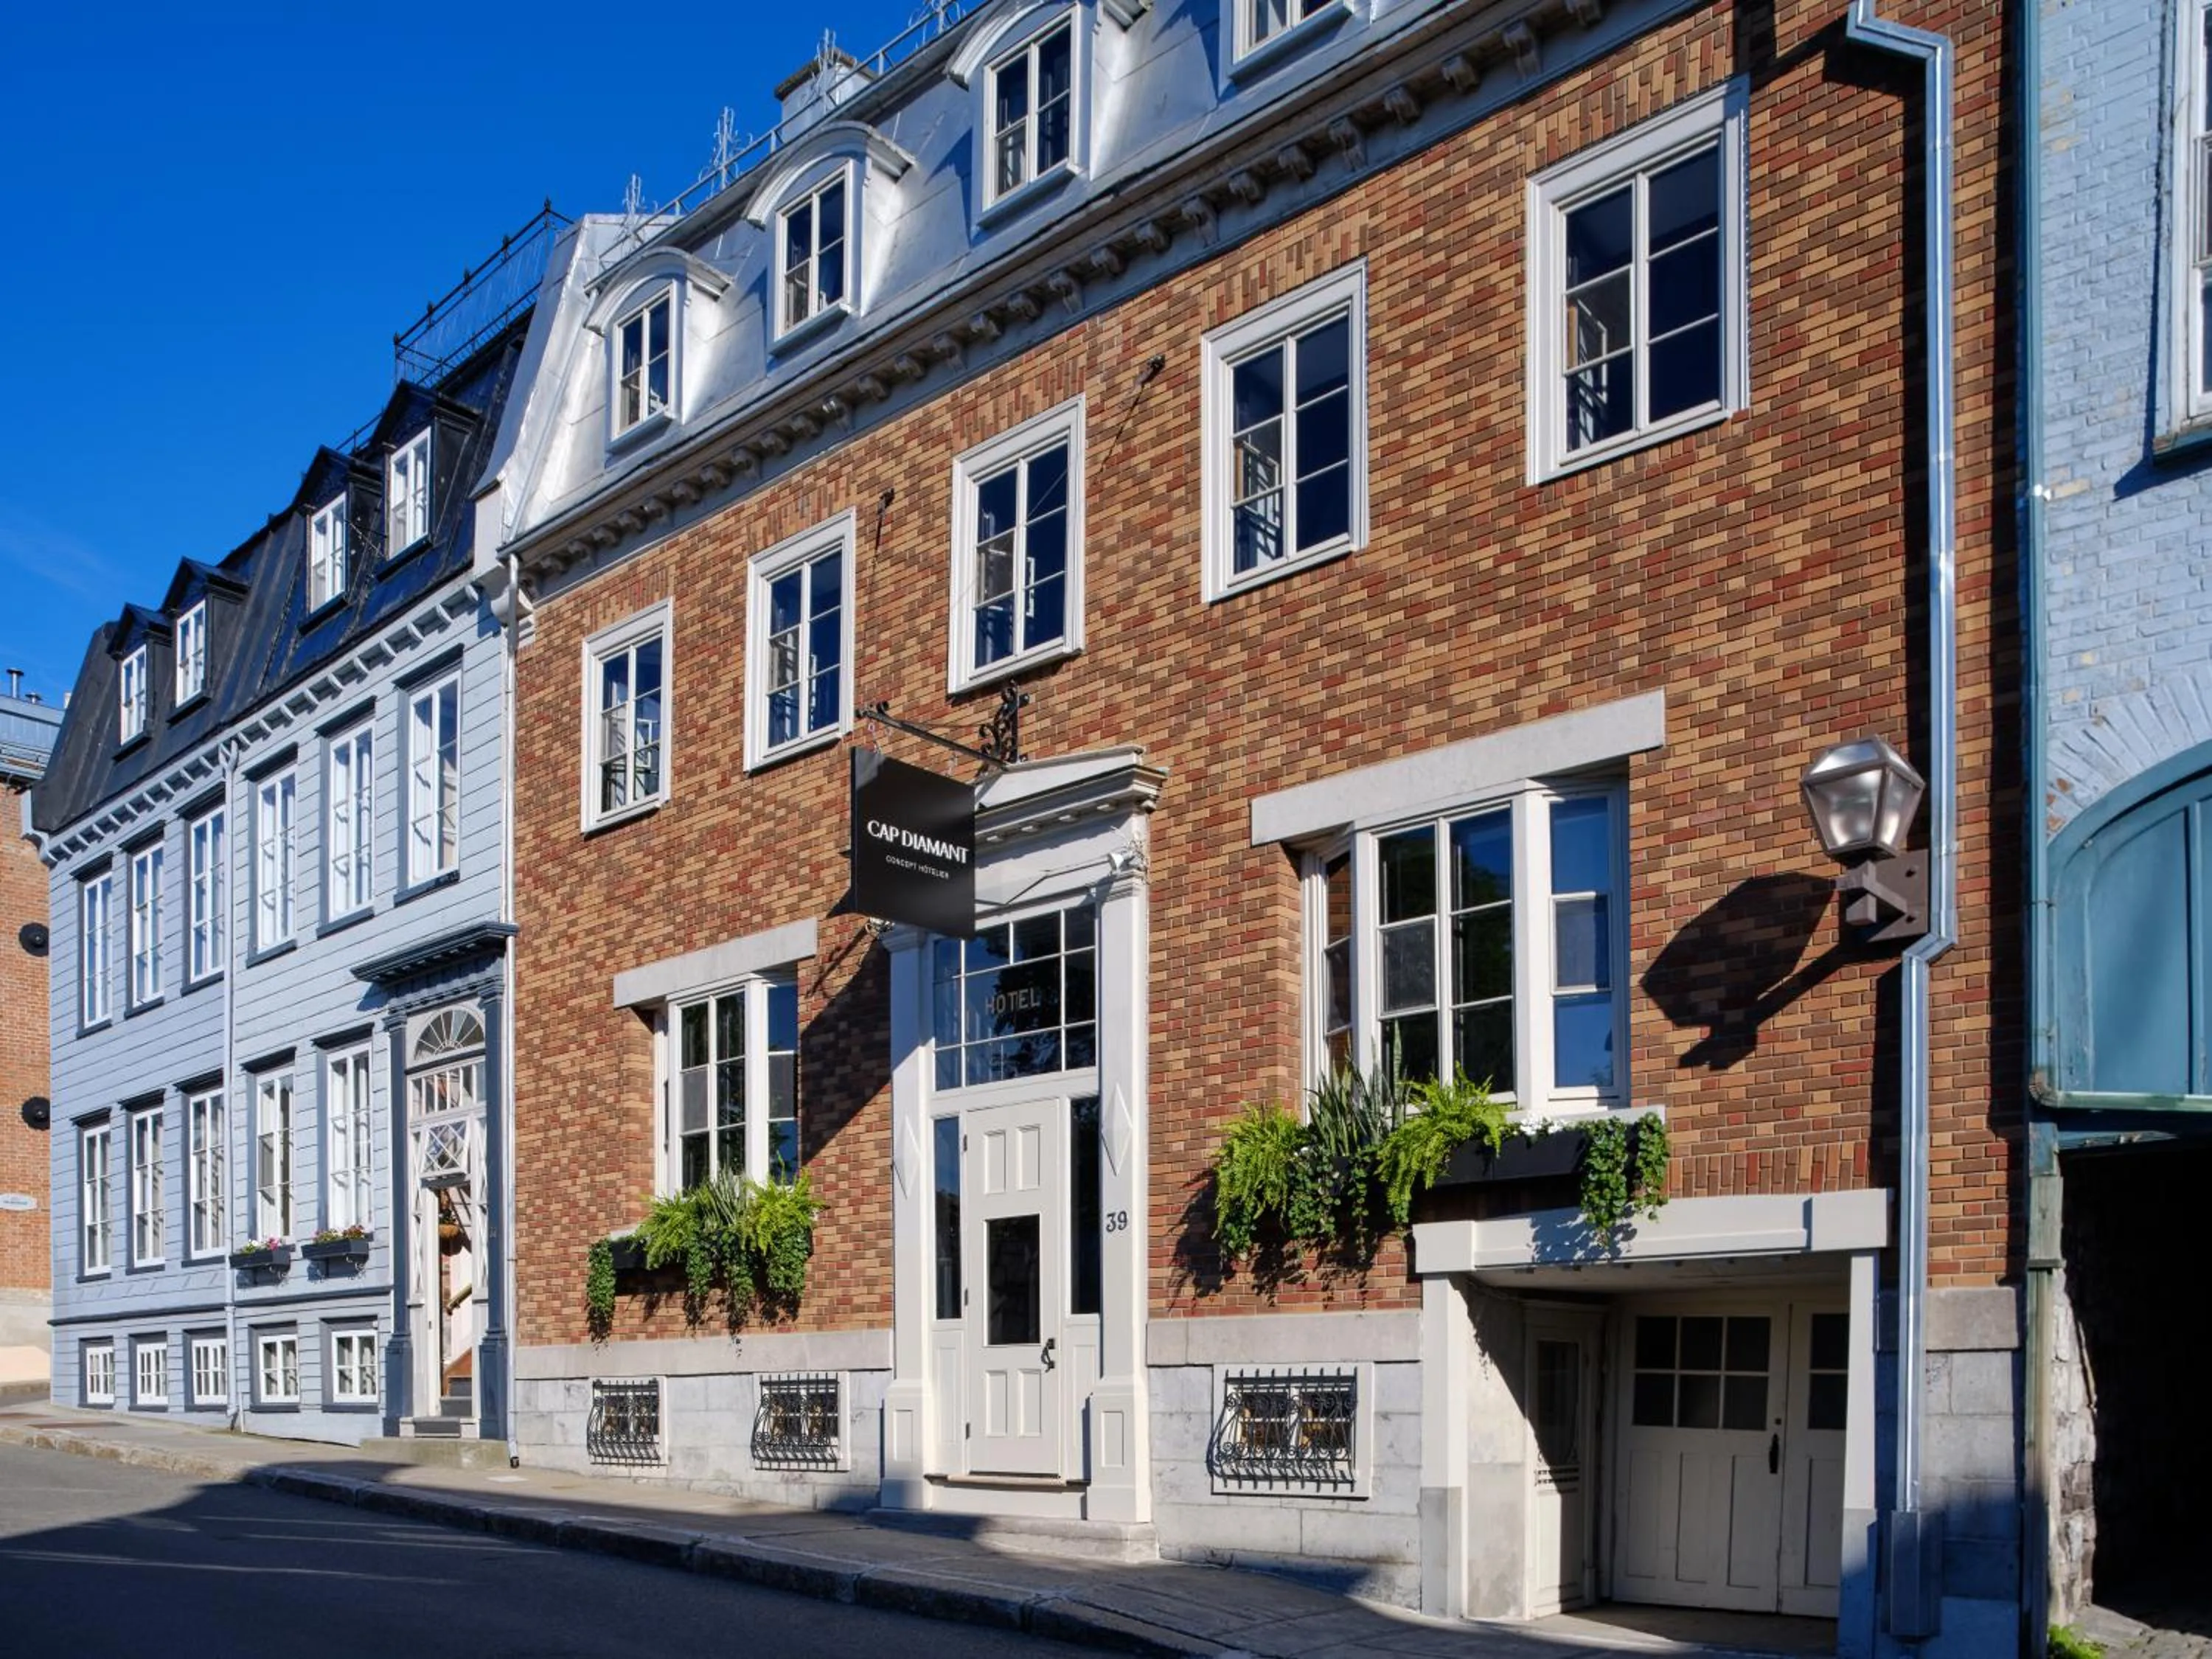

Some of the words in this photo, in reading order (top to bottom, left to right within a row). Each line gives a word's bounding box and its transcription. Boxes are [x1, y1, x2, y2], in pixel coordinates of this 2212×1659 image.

[867, 820, 900, 843] CAP
[902, 830, 970, 863] DIAMANT
[886, 855, 917, 870] CONCEPT
[1106, 1210, 1127, 1233] 39
